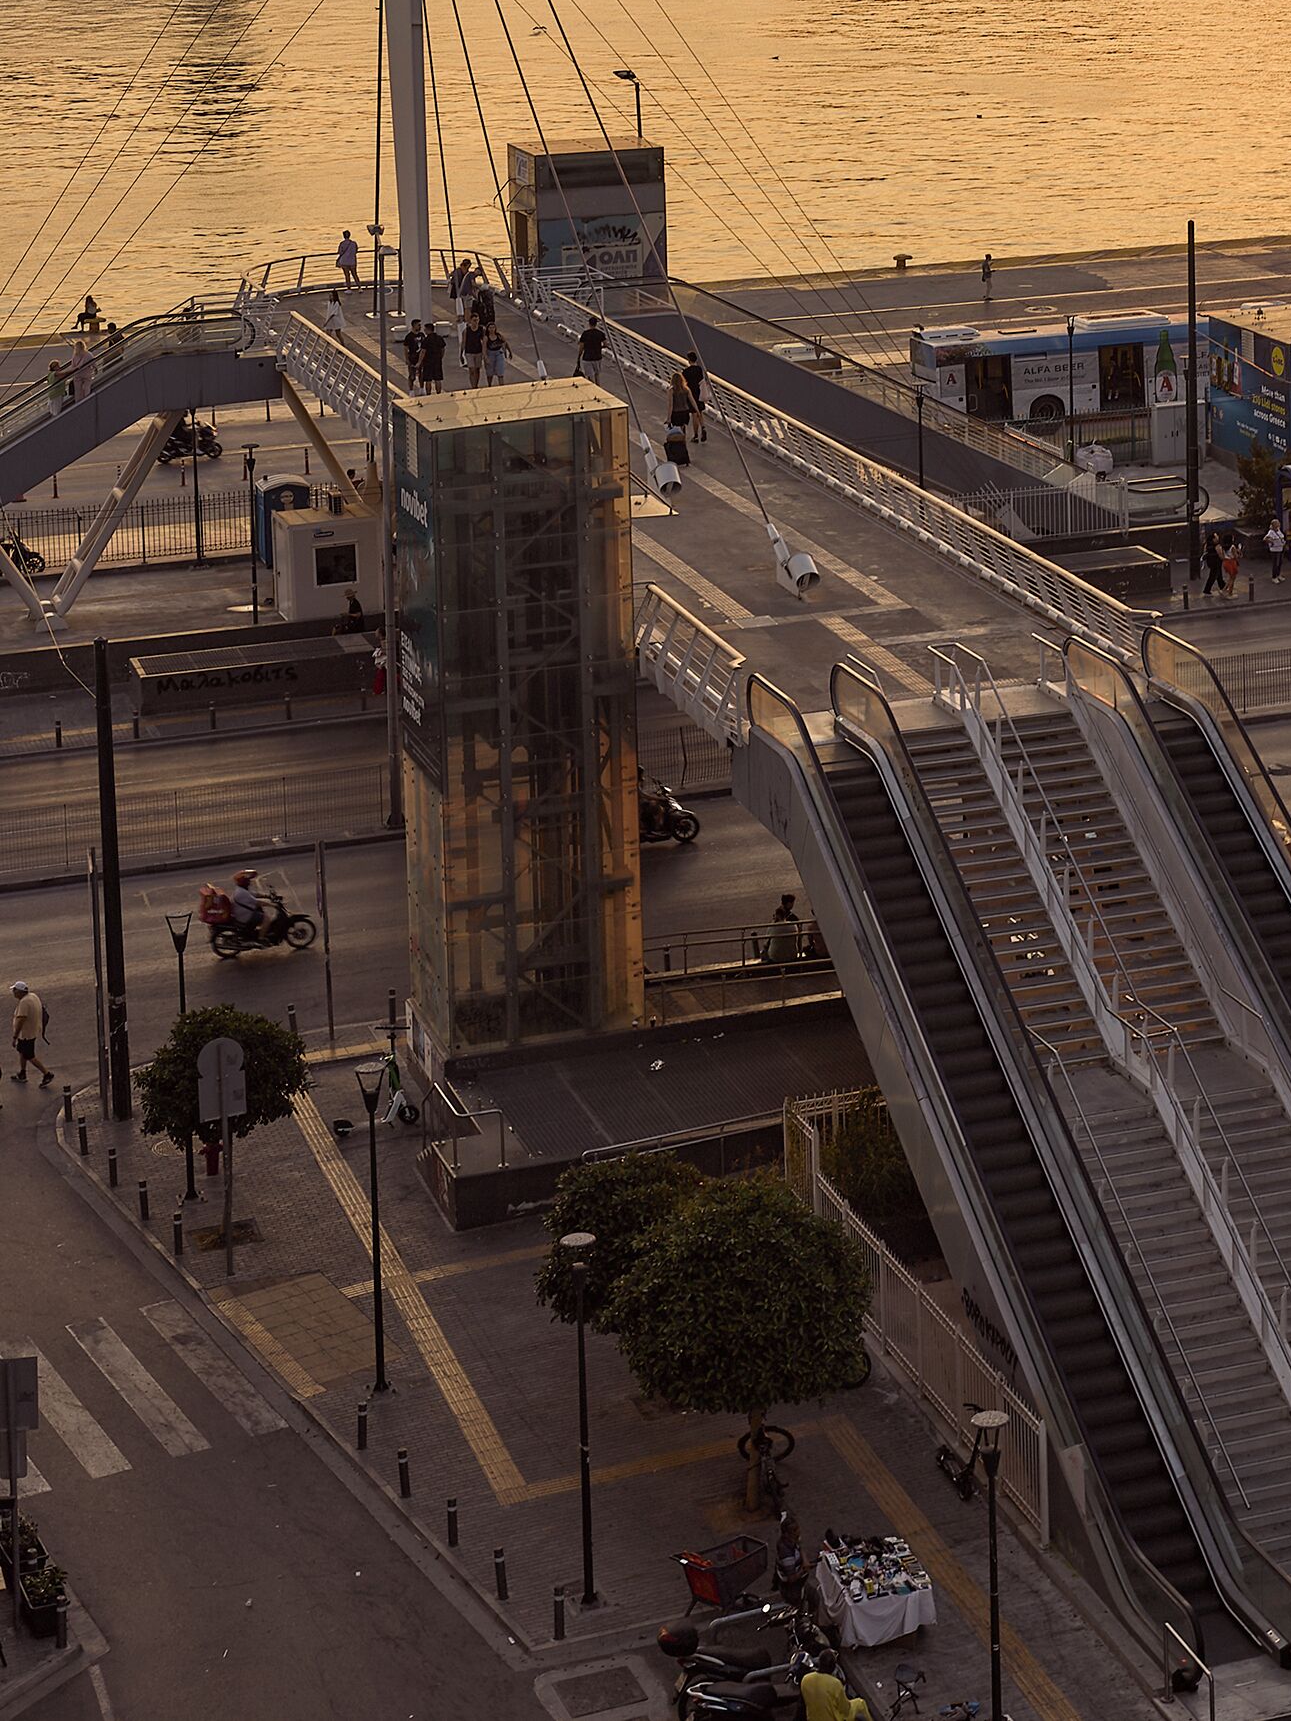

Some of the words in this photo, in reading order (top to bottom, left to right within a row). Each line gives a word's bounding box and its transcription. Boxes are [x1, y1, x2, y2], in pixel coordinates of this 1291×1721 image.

[1023, 365, 1051, 375] ALFA
[1055, 362, 1085, 372] BEER
[401, 488, 428, 528] novibet
